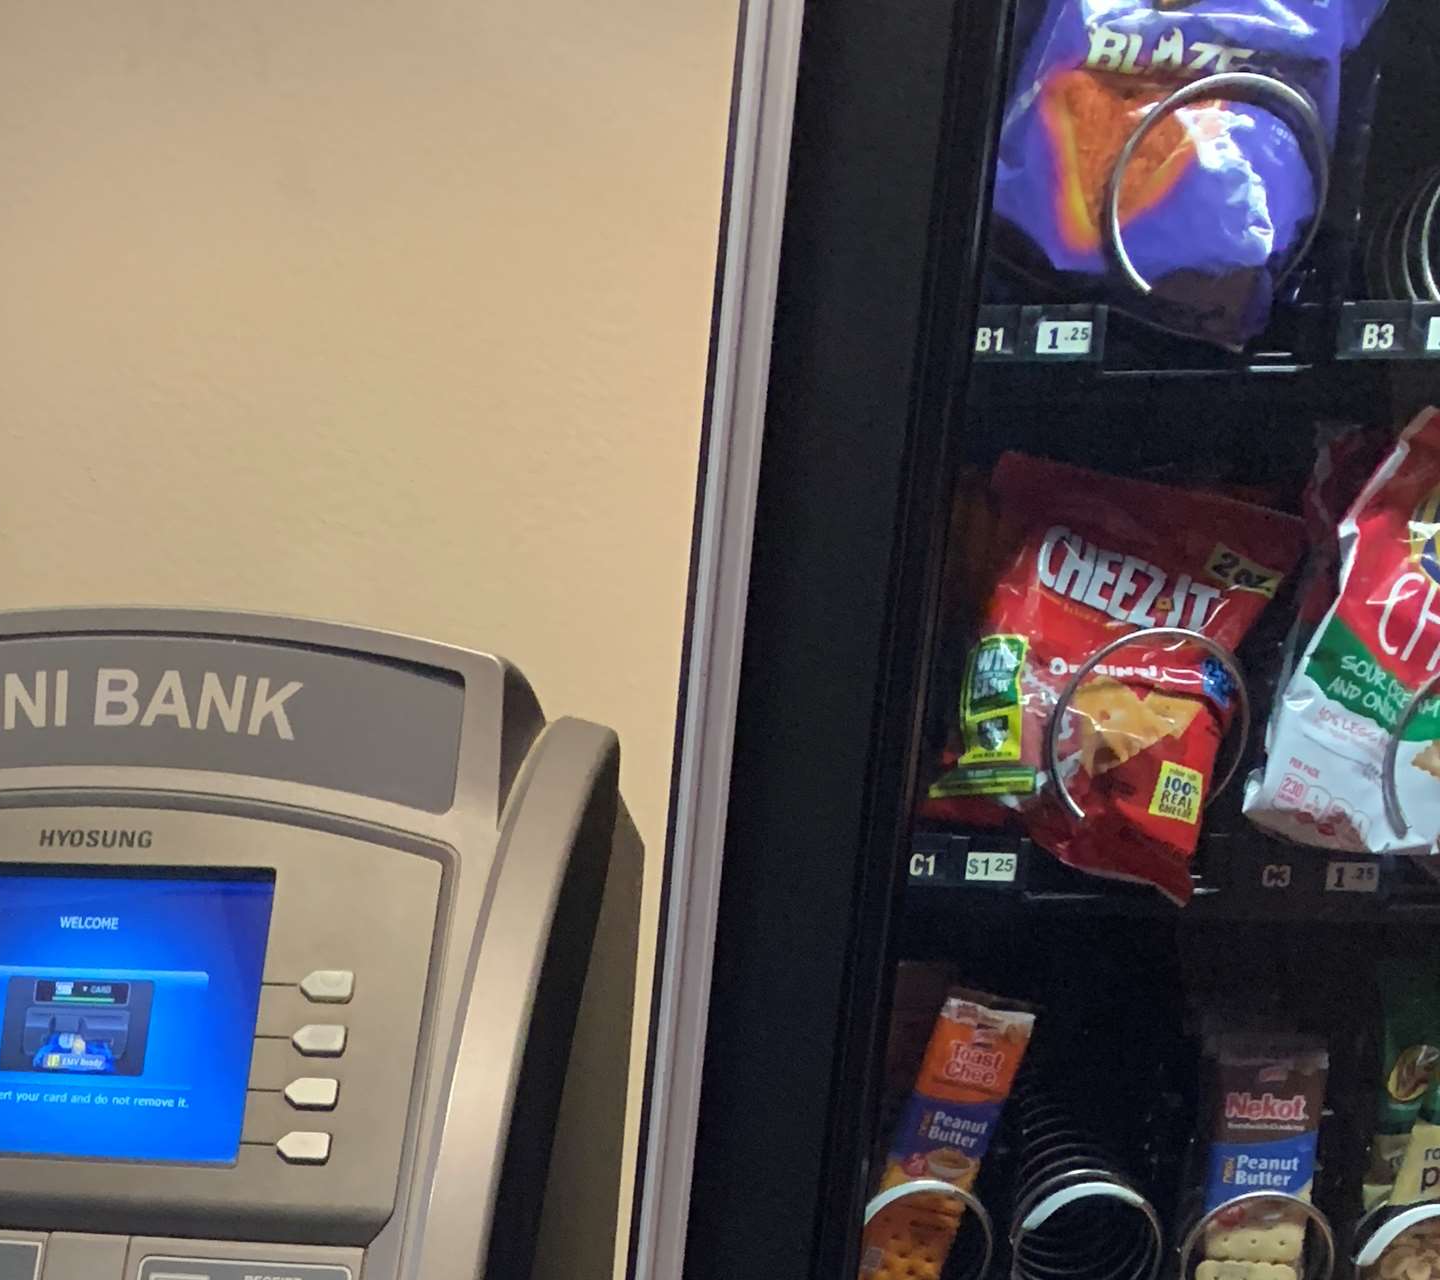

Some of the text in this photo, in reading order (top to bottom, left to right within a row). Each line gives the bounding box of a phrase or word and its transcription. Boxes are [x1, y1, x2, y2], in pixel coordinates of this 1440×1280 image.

[1088, 27, 1254, 73] BLAZE
[975, 327, 1005, 352] B1
[1362, 323, 1395, 350] B3
[1050, 657, 1158, 677] Orginal
[1340, 655, 1387, 690] SOUR
[1327, 676, 1361, 700] AND
[93, 667, 304, 741] BANK
[1160, 791, 1193, 810] REAL
[38, 828, 154, 850] HYOSUNG
[909, 853, 936, 876] C1
[1261, 864, 1292, 888] C3
[59, 915, 120, 931] WELCOME
[950, 1040, 1005, 1072] Toast
[944, 1060, 997, 1088] Chee
[15, 1091, 40, 1103] your
[43, 1091, 68, 1103] card
[70, 1092, 91, 1104] and
[94, 1093, 109, 1105] do
[112, 1095, 130, 1107] not
[133, 1096, 175, 1109] remove
[1224, 1091, 1306, 1121] Nekot
[933, 1110, 989, 1135] Peanut
[928, 1125, 979, 1149] Butter
[1237, 1154, 1300, 1172] Peanut
[1235, 1169, 1292, 1187] Butter
